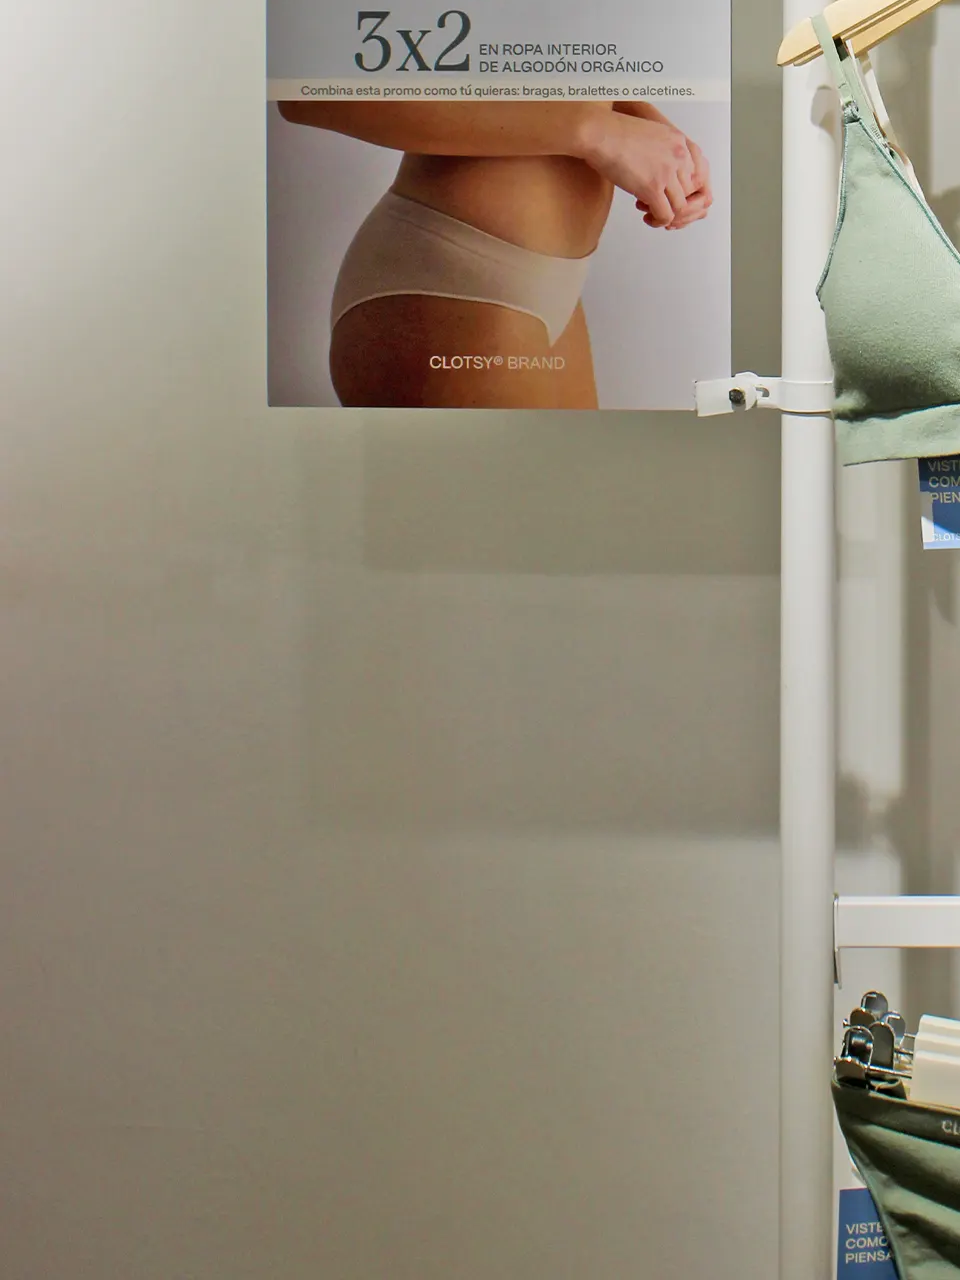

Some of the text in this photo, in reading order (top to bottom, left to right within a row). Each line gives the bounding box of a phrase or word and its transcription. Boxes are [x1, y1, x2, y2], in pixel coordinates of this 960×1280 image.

[353, 9, 471, 72] 3x2
[479, 43, 617, 56] EN ROPA INTERIOR
[479, 56, 664, 73] DE ALGODÓN ORGÁNICO
[300, 84, 696, 98] Combina esta promo como tú quieras: bragas, bralettes o calcetines.
[507, 355, 566, 370] BRAND
